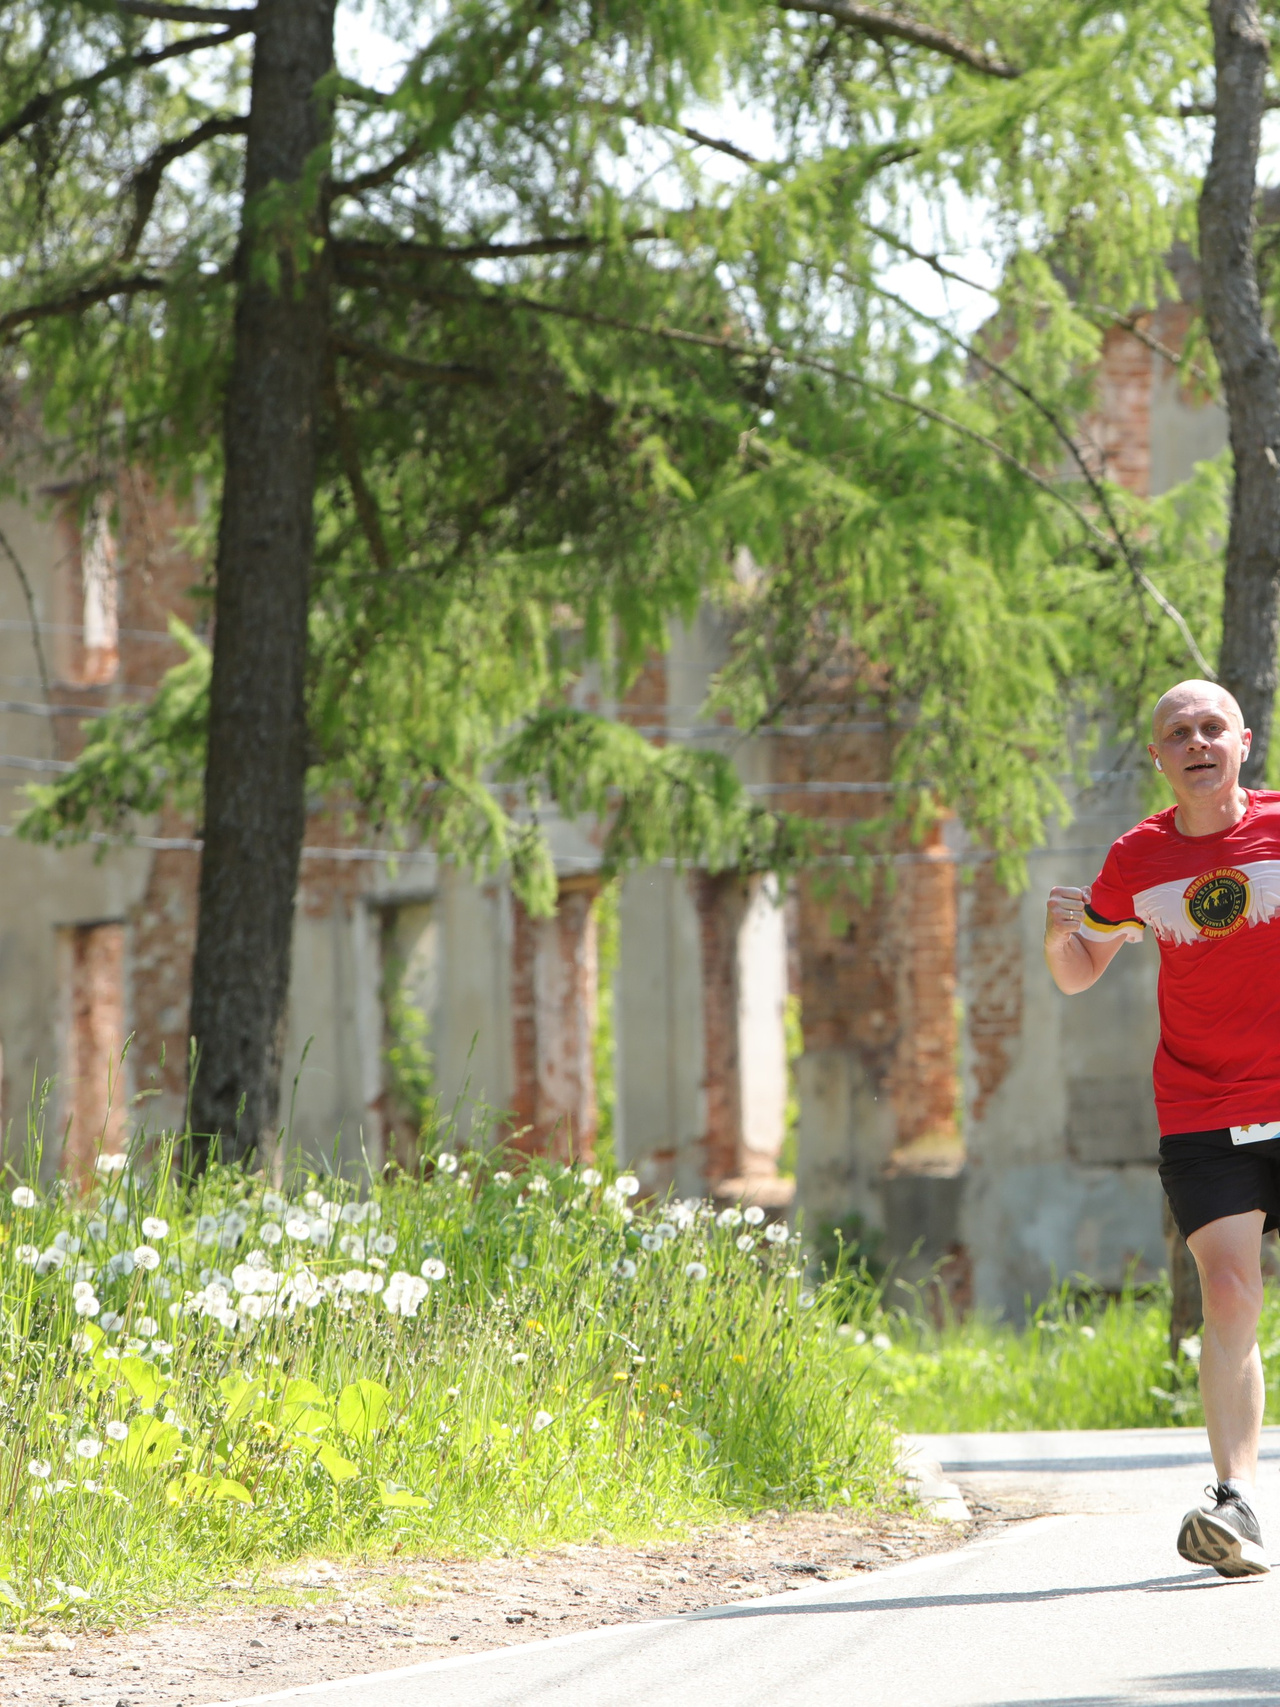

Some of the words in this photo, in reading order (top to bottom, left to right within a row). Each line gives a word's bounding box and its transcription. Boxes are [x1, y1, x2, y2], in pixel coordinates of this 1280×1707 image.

[1186, 872, 1214, 898] SPARTAK
[1216, 869, 1246, 883] MOSCOW
[1204, 917, 1244, 937] SUPPORTERS
